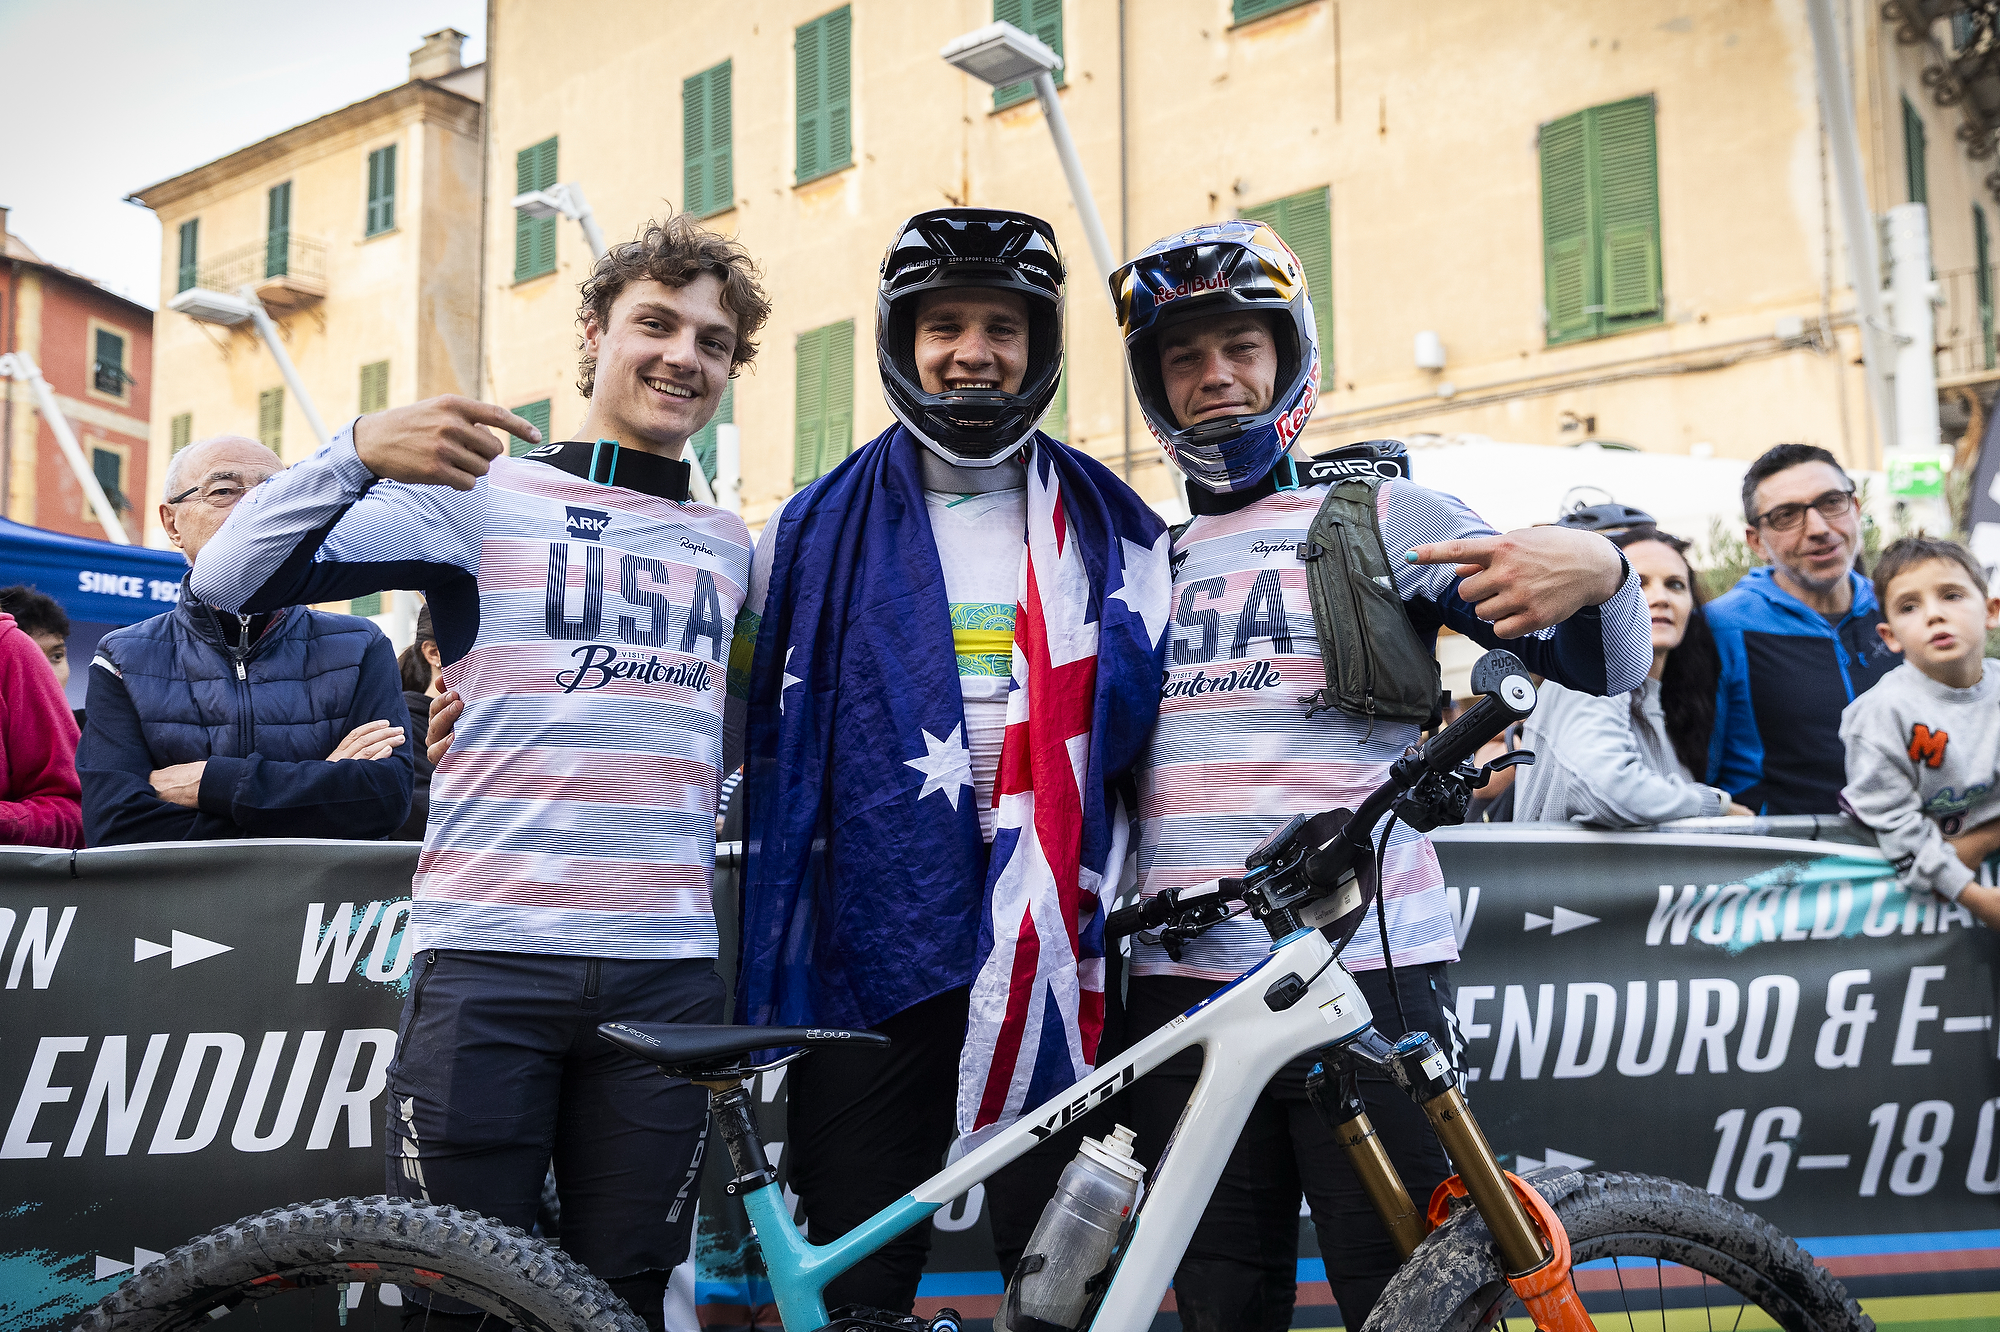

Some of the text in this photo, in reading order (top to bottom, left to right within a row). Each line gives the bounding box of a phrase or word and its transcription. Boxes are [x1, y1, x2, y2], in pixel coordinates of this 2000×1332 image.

[1153, 270, 1230, 308] Red Bull
[1308, 459, 1402, 480] GIRO
[566, 514, 608, 533] ARK
[78, 570, 145, 599] SINCE
[545, 541, 723, 663] USA
[621, 651, 645, 660] VISIT
[1172, 671, 1193, 680] VISIT
[1908, 722, 1949, 769] M
[1645, 884, 1852, 946] WORLD
[1333, 1004, 1342, 1015] 5
[615, 1023, 661, 1047] BURGTEC
[806, 1031, 851, 1039] CLOUD
[1456, 974, 1800, 1081] ENDURO
[1814, 969, 1877, 1070] &
[1435, 1060, 1443, 1070] 5
[0, 1028, 399, 1159] ENDUR
[1028, 1062, 1134, 1142] YETI
